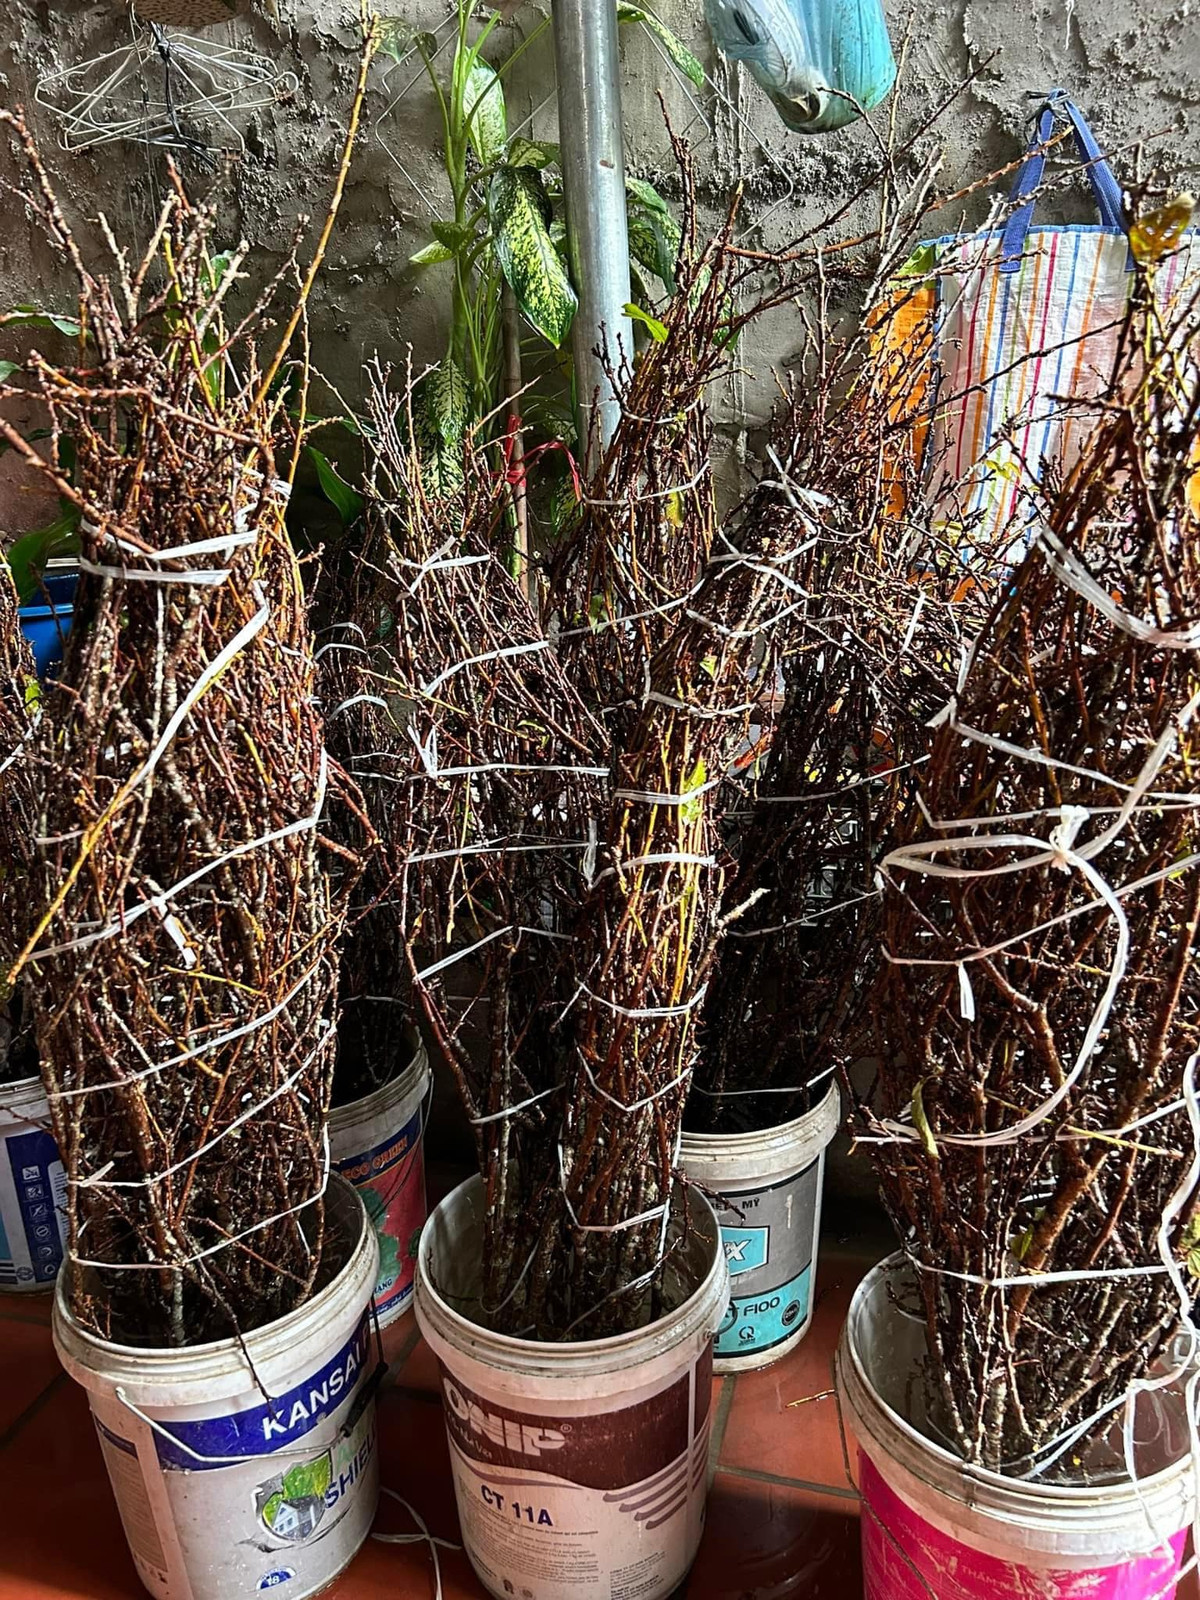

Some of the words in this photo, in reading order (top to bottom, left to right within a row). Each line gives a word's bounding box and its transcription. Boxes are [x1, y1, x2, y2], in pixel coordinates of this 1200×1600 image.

[262, 1341, 360, 1441] KANSAI
[481, 1484, 504, 1511] CT
[512, 1502, 554, 1526] 11A
